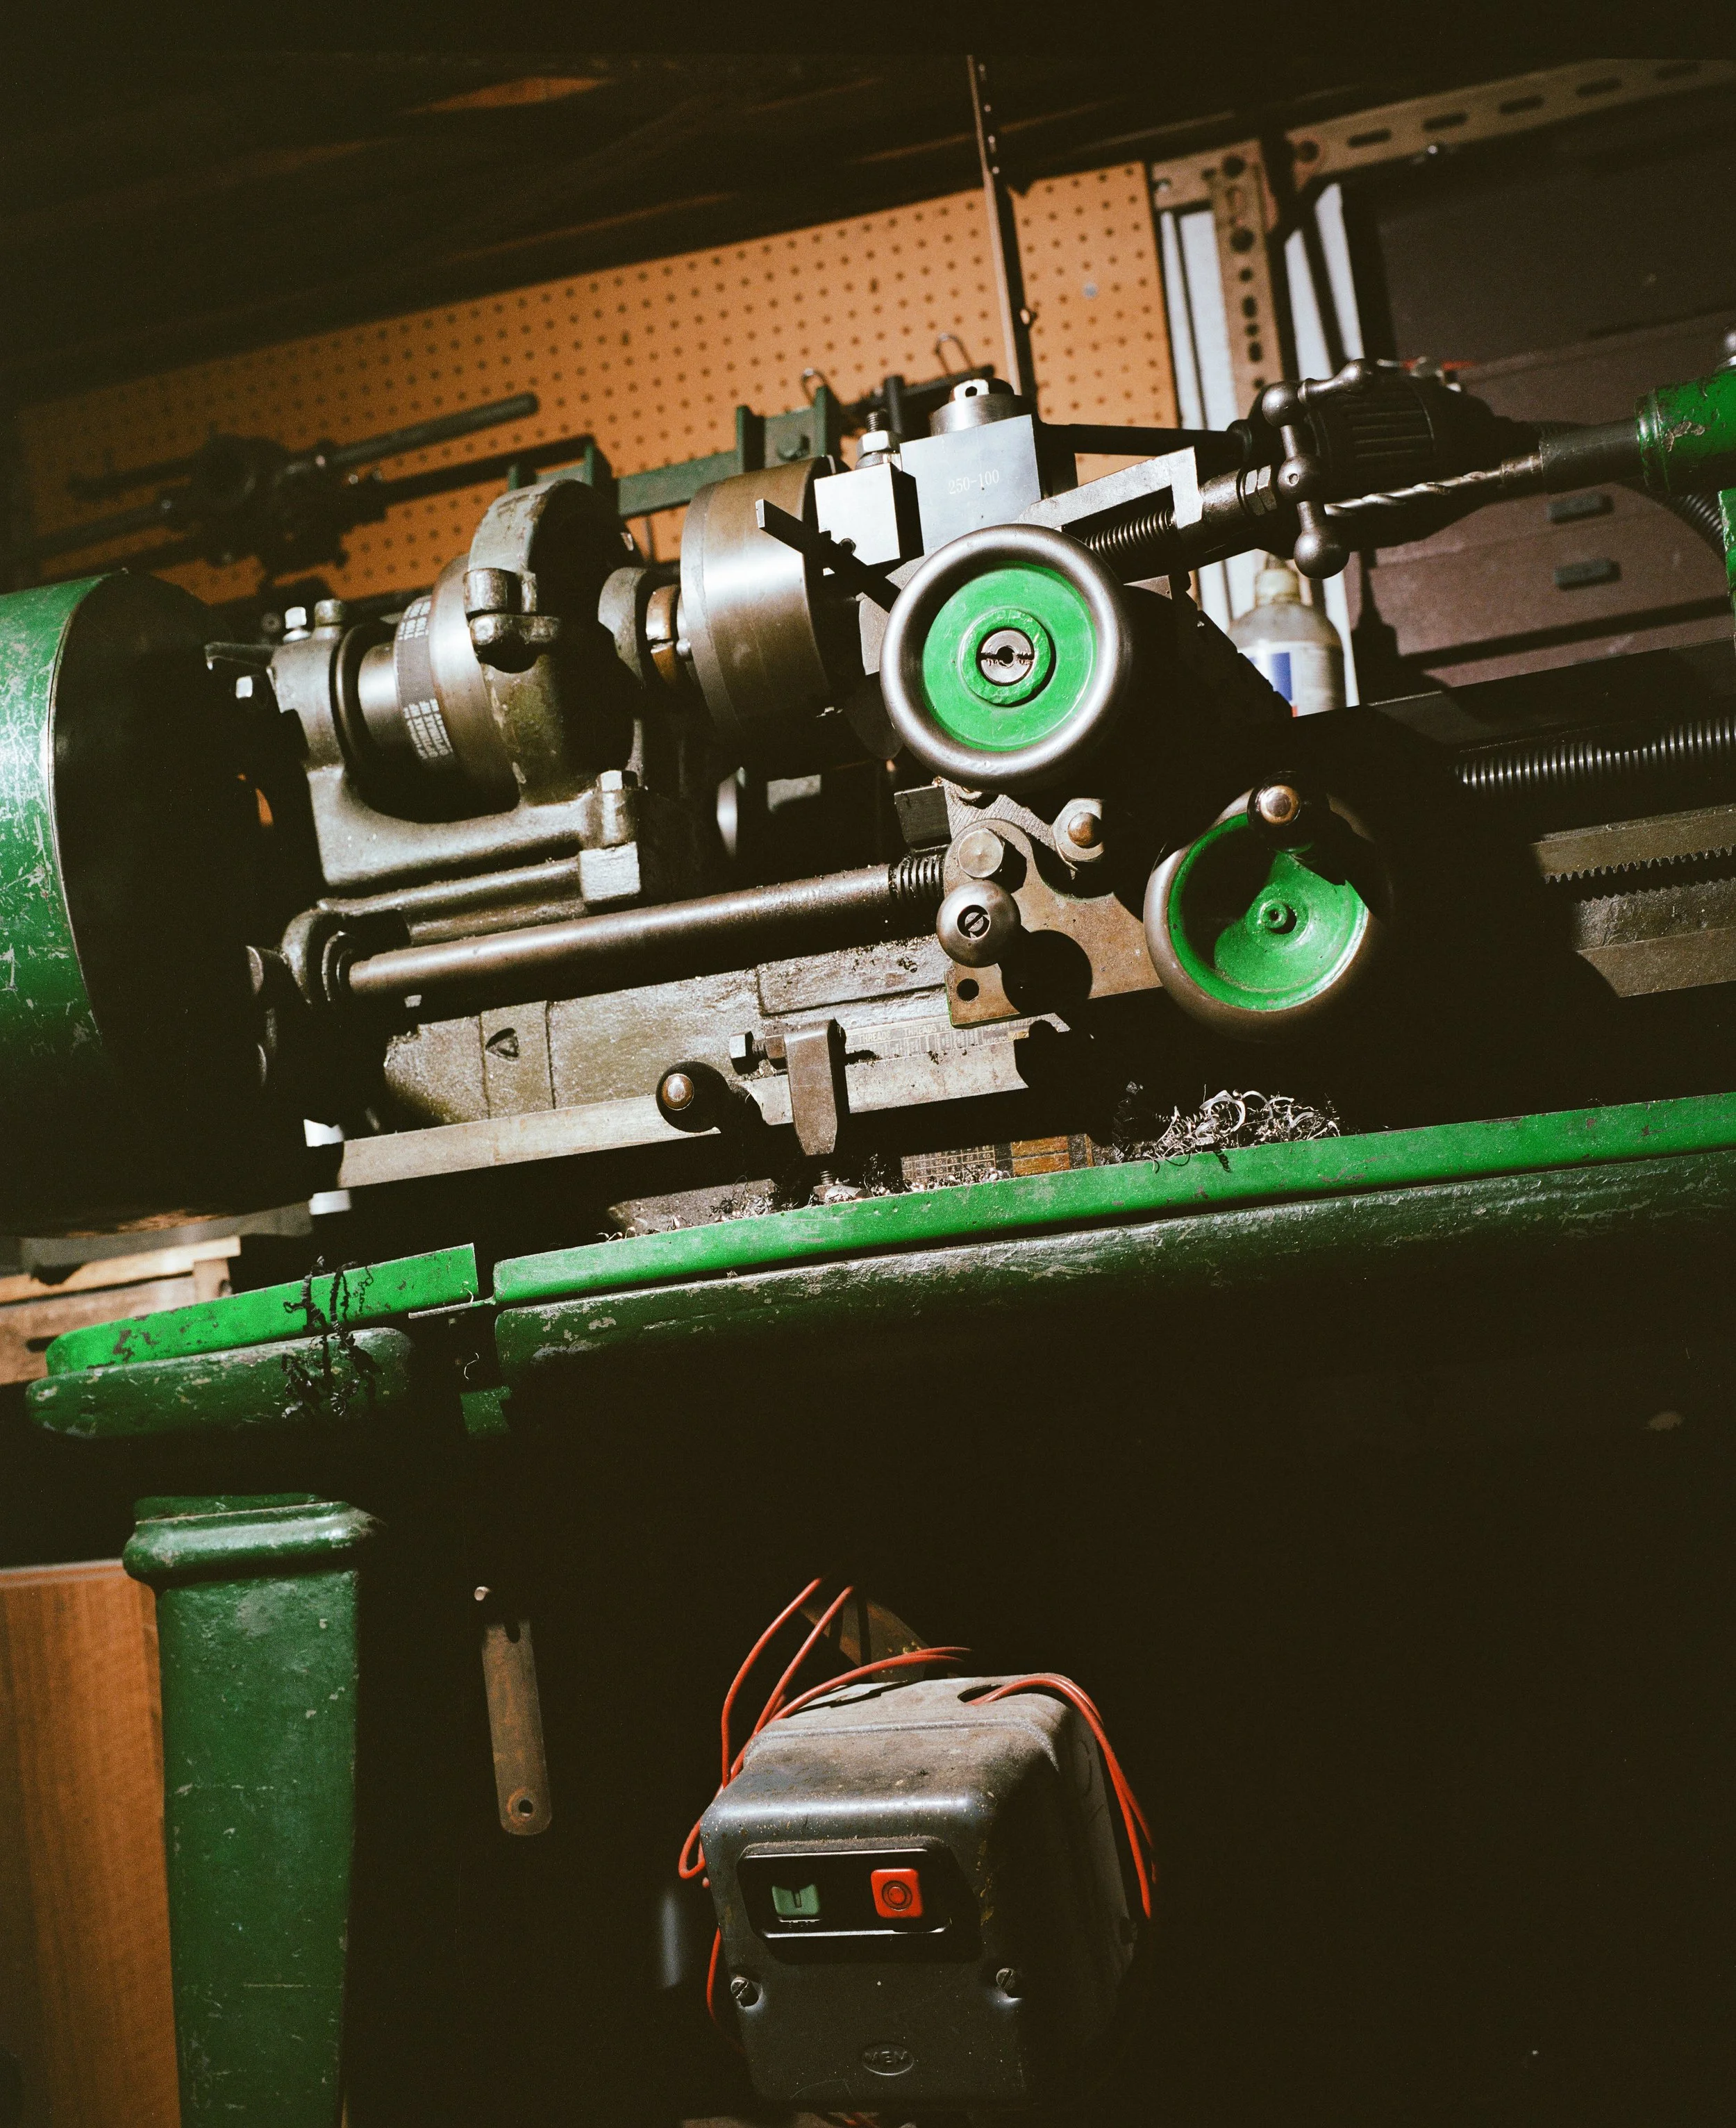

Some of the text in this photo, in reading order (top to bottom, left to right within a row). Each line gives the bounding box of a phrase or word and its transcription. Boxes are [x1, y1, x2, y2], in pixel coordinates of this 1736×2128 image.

[949, 469, 999, 494] 250-100
[859, 1031, 891, 1042] THREADS
[904, 1024, 937, 1036] THREADS
